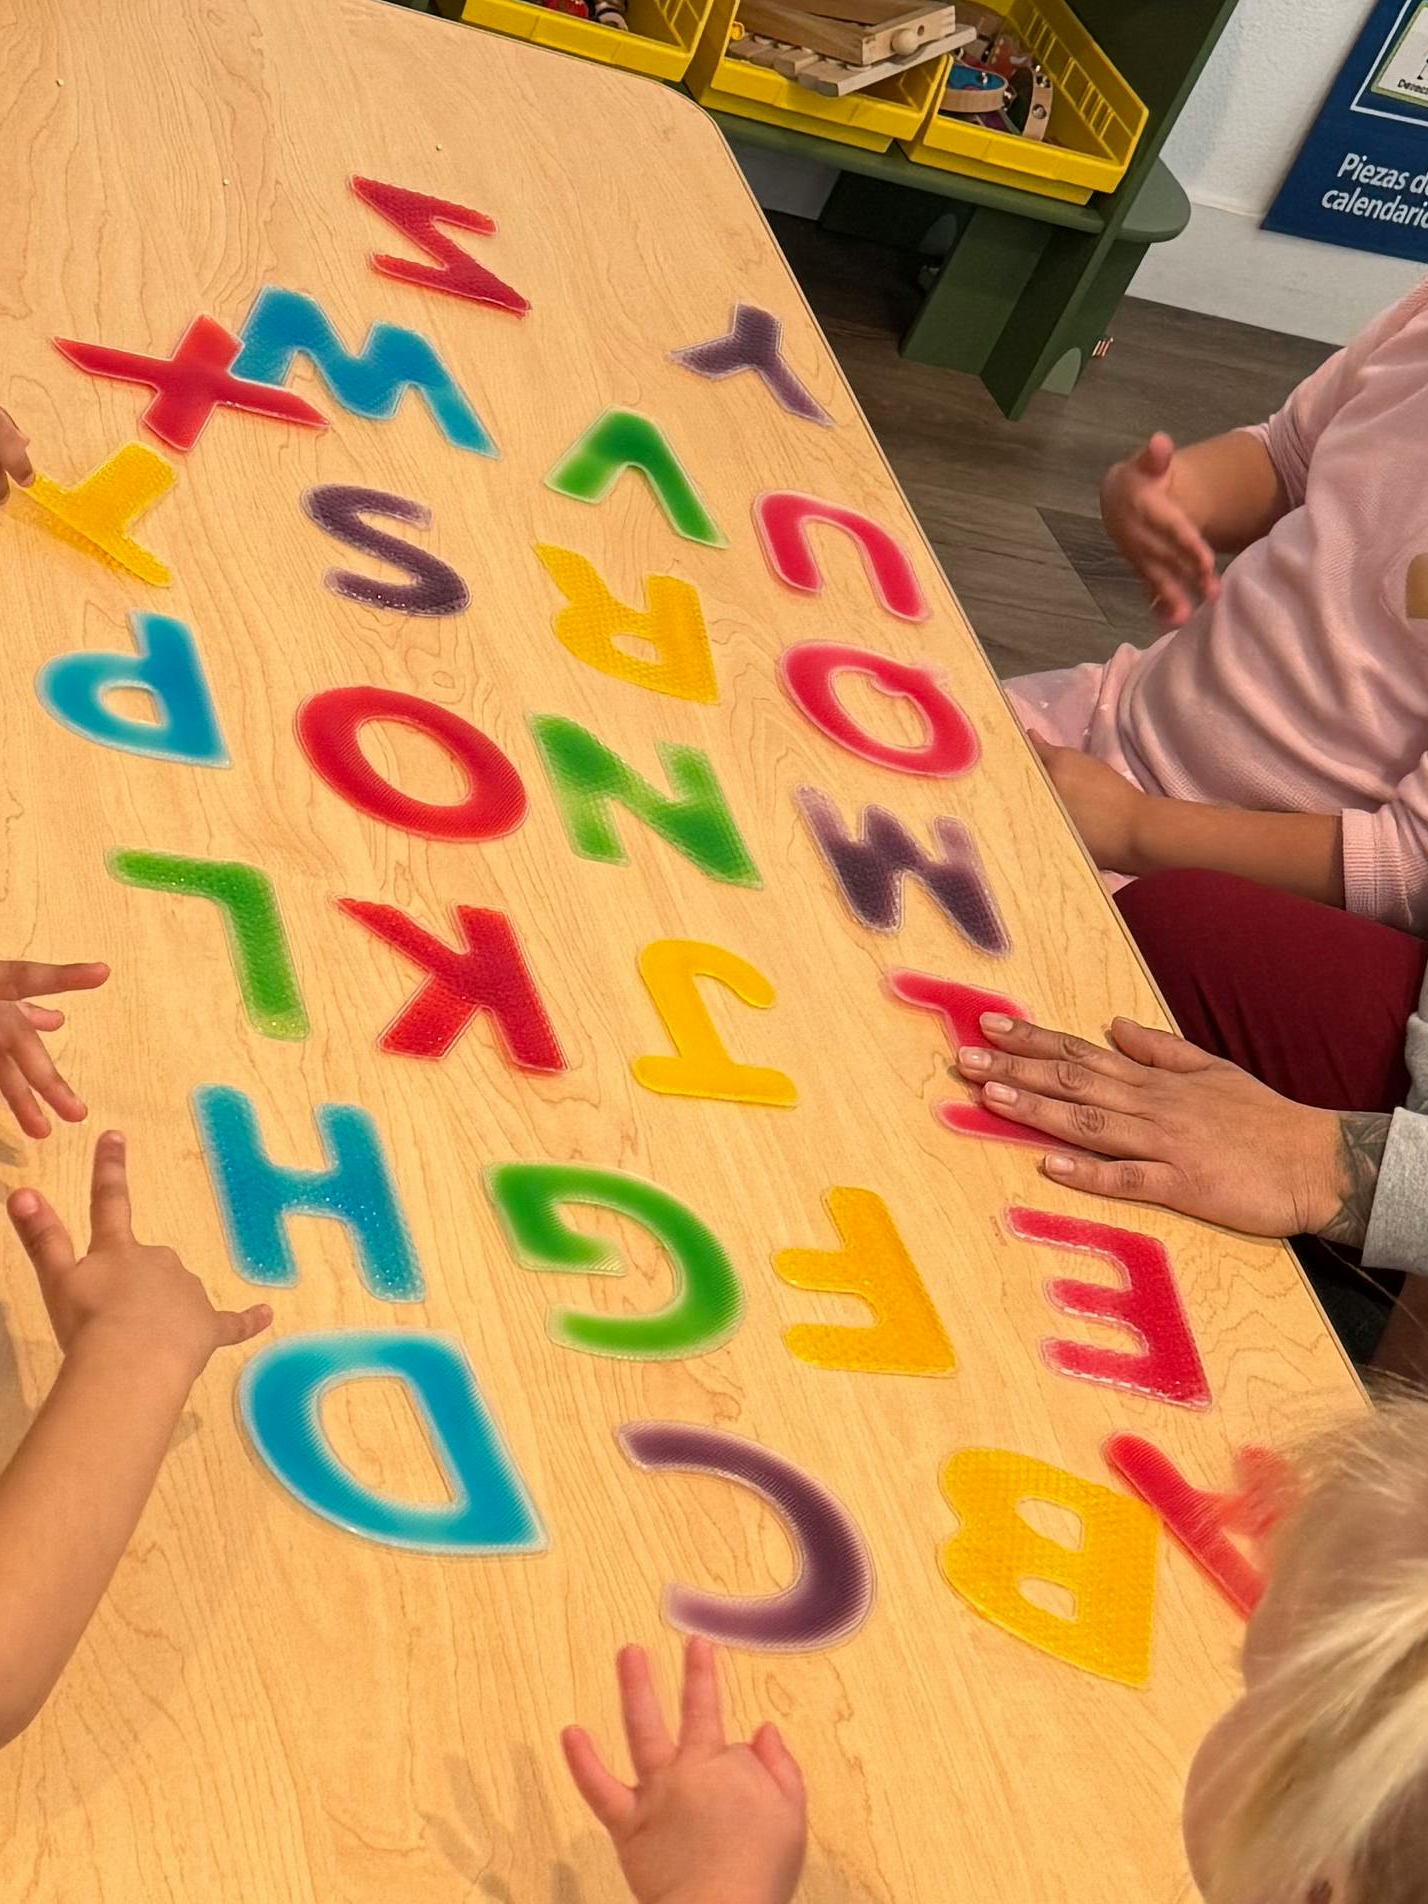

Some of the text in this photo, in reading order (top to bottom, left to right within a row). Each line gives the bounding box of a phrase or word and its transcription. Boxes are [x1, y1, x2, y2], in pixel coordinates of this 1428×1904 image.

[1336, 152, 1410, 191] Piezas
[54, 312, 329, 451] X
[668, 302, 831, 426] Y
[22, 441, 176, 587] T
[303, 484, 470, 617] S
[545, 406, 728, 547] V
[36, 610, 231, 768] P
[533, 543, 719, 703] R
[296, 686, 530, 842] O
[528, 710, 762, 888] N
[107, 847, 309, 1042] L
[336, 897, 568, 1076] K
[632, 939, 799, 1108] J
[191, 1083, 1213, 1409] E F G H
[238, 1328, 551, 1558] D
[617, 1419, 876, 1655] C
[937, 1445, 1166, 1688] B
